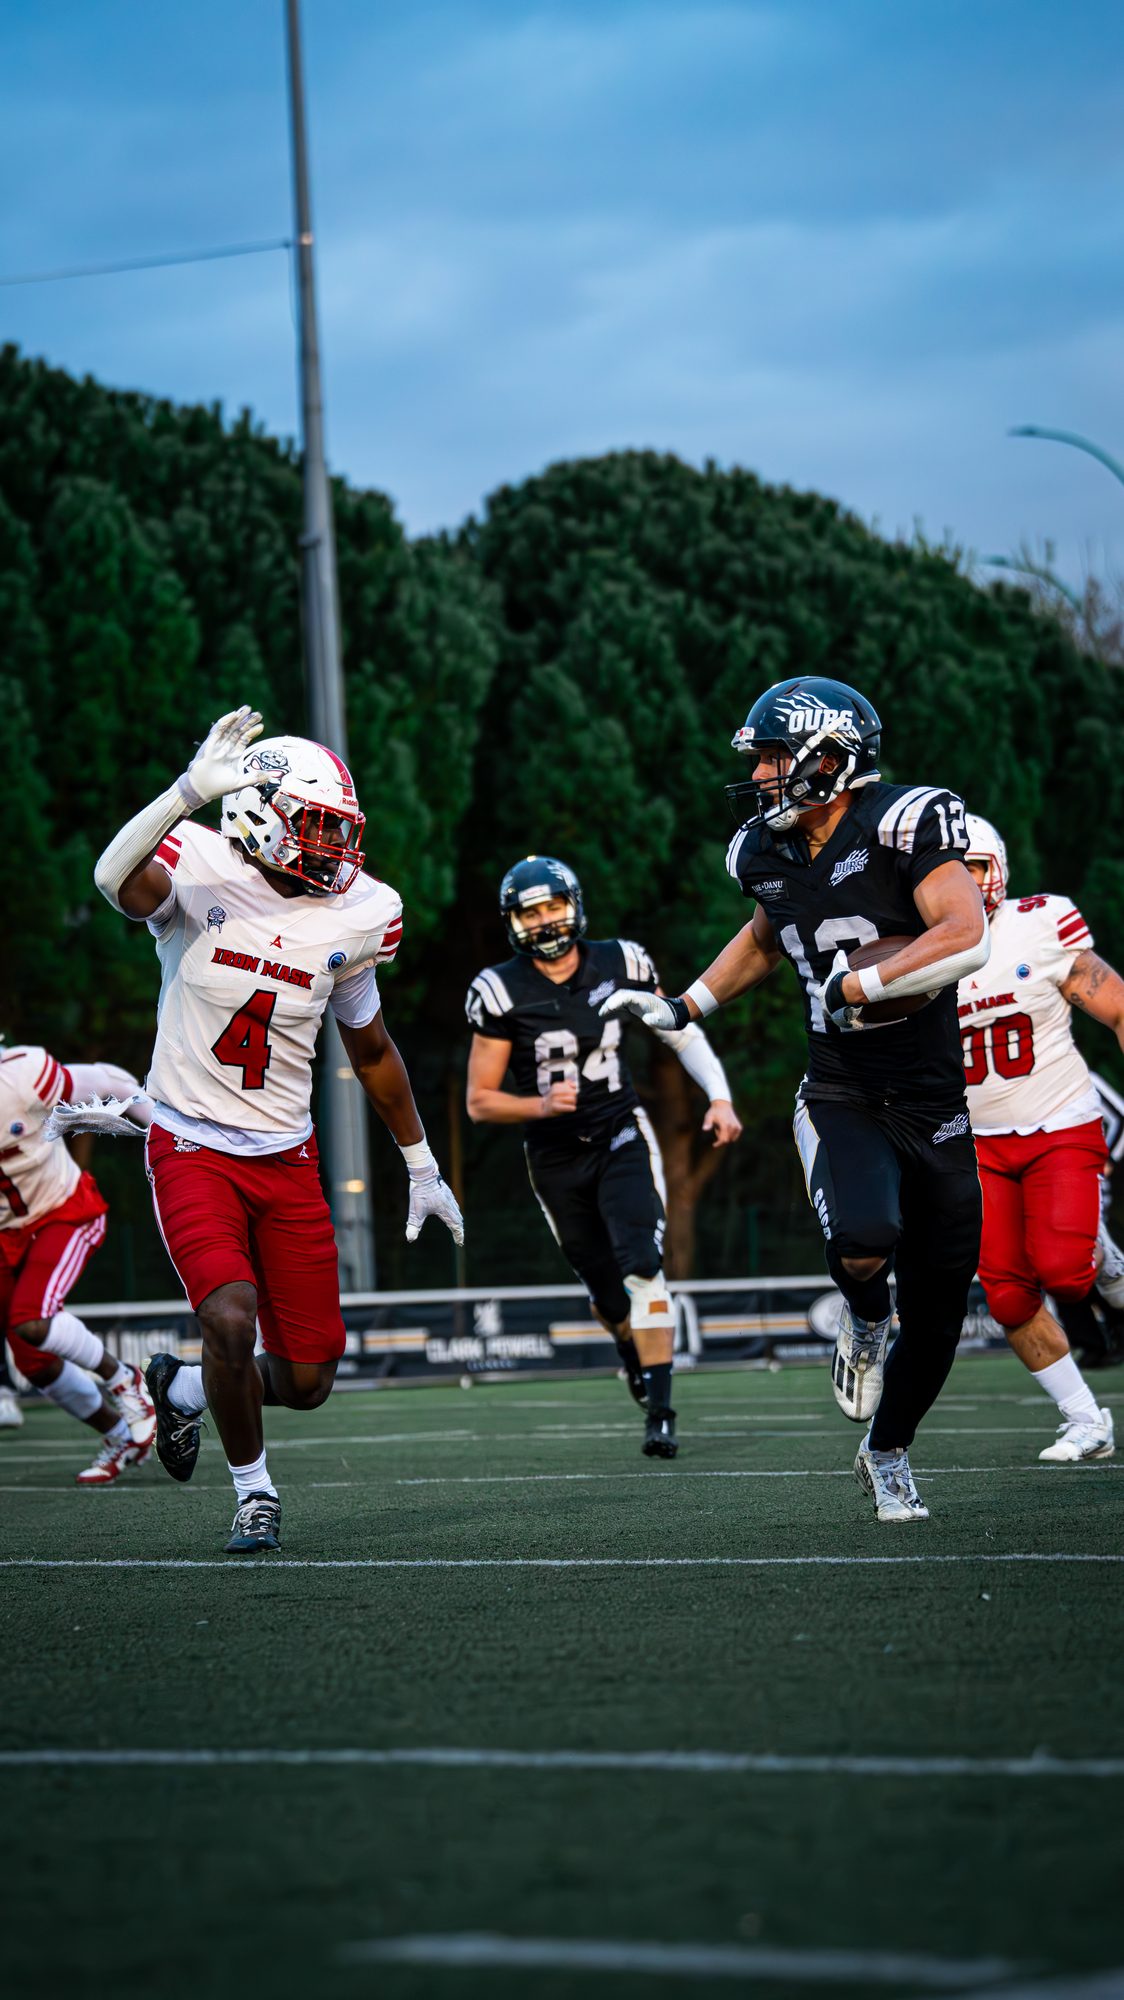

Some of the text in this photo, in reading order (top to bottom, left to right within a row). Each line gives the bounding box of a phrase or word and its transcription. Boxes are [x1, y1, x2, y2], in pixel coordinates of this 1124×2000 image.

[788, 708, 853, 734] OURS
[933, 800, 969, 850] 12
[211, 947, 315, 990] IRON MASK
[211, 989, 277, 1090] 4
[535, 1018, 623, 1098] 84
